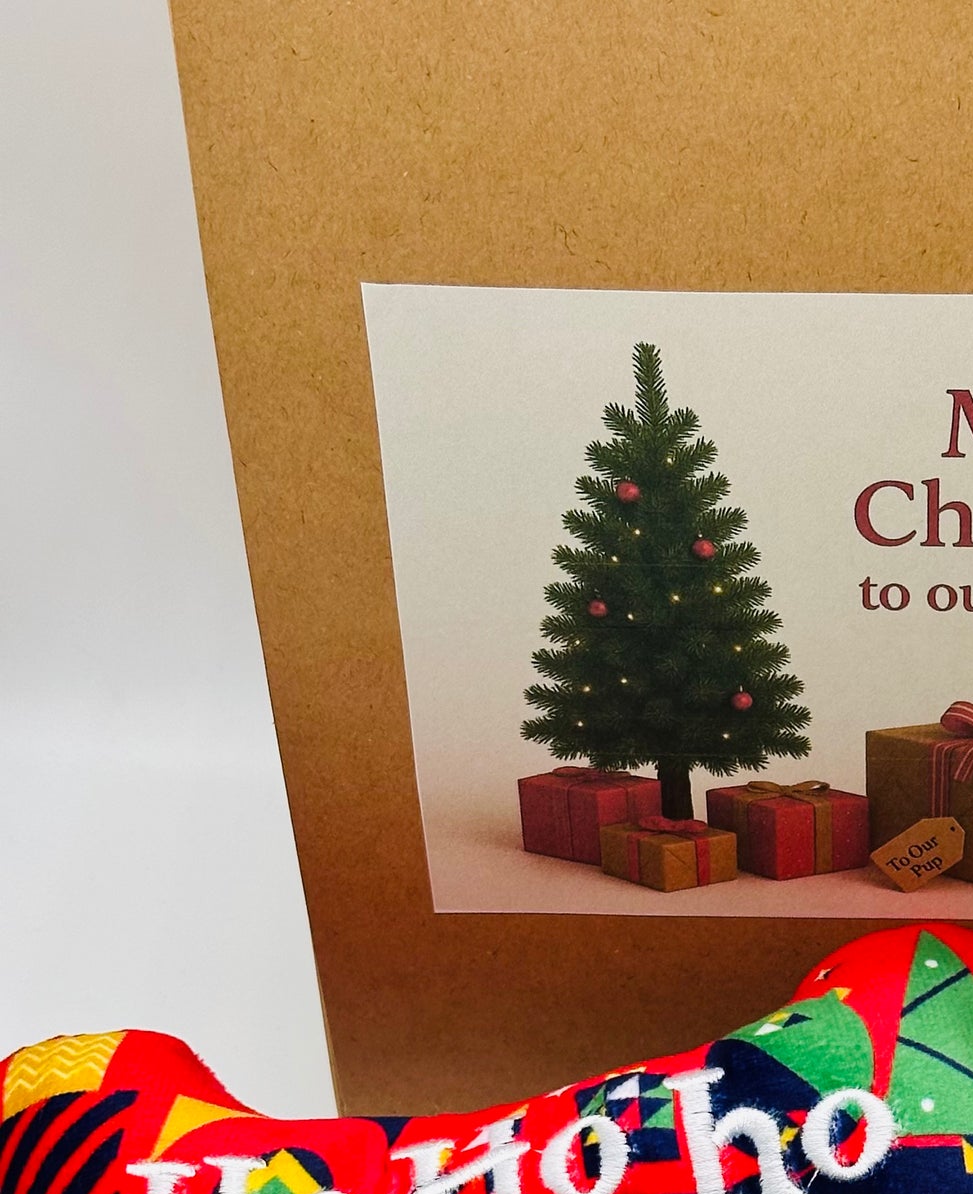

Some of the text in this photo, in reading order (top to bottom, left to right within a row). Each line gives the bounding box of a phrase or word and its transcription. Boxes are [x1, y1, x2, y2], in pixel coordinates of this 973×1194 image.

[859, 576, 910, 612] to
[886, 836, 940, 872] To Our
[910, 856, 943, 878] Pup
